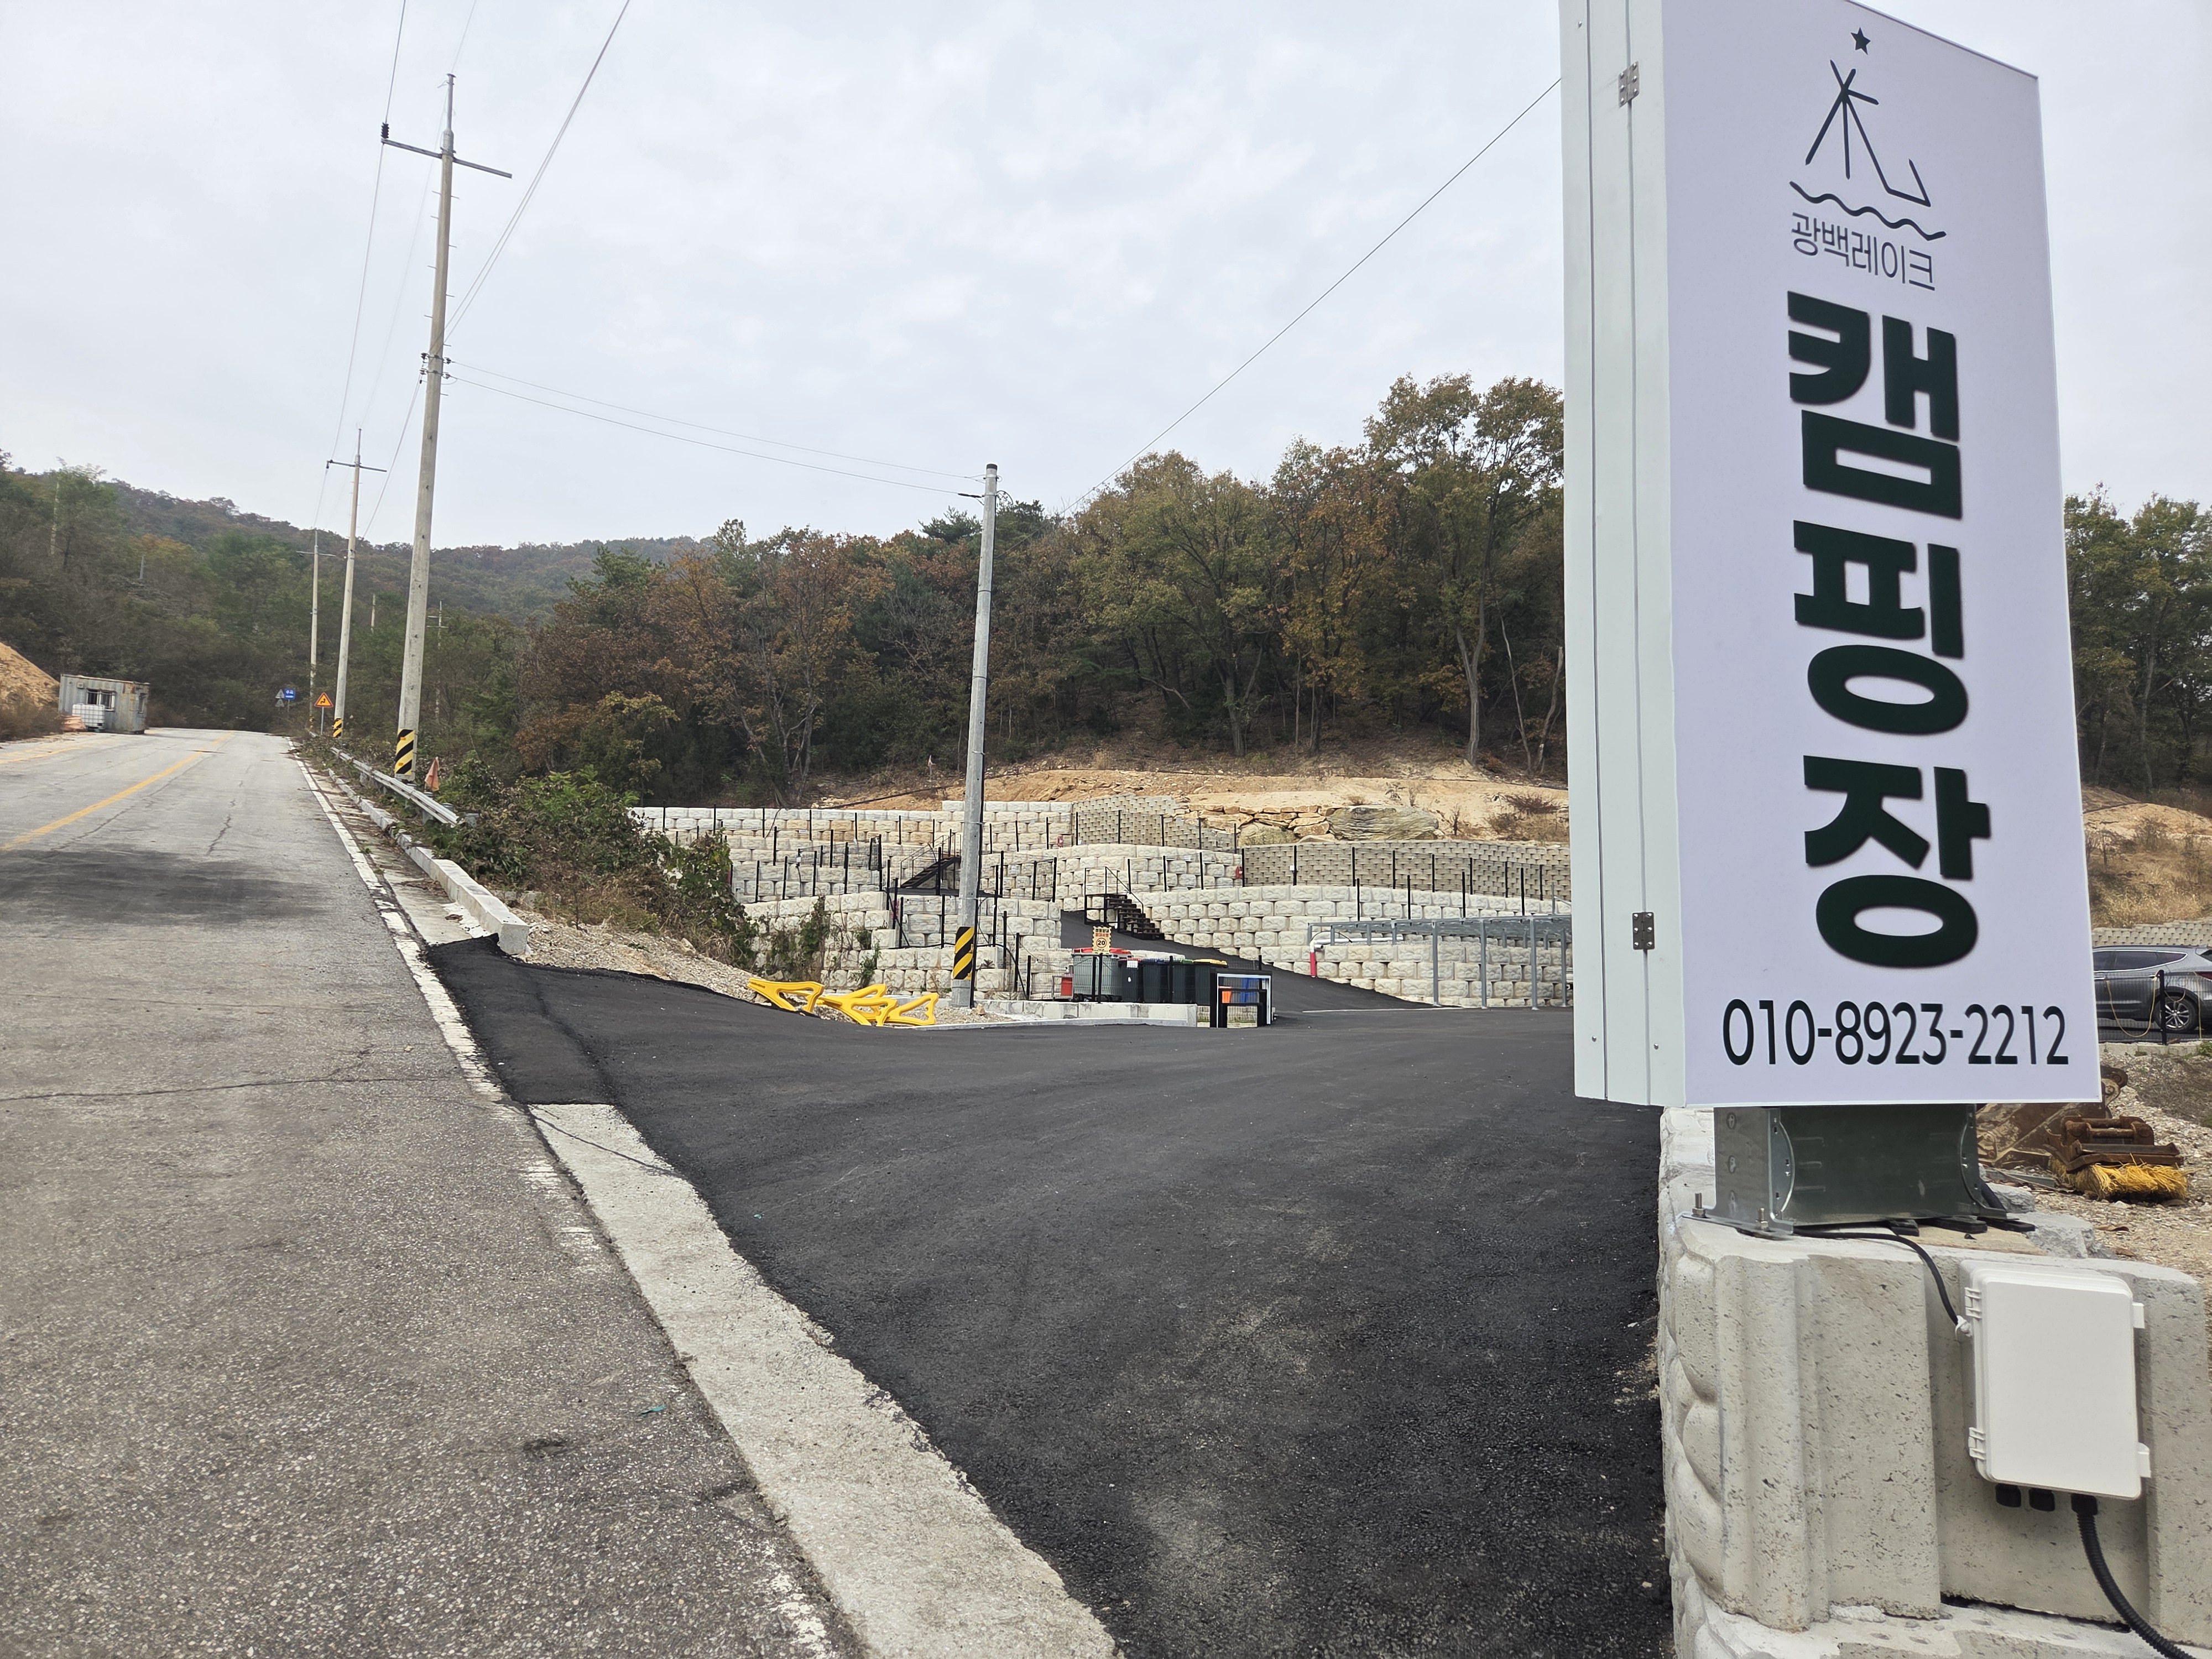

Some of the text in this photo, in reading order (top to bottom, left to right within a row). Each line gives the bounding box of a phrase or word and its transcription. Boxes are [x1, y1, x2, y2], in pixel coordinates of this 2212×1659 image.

[1791, 212, 1936, 291] 광백레이크
[1787, 290, 1992, 970] 캠핑장
[1722, 998, 2069, 1066] 010-8923-2212
